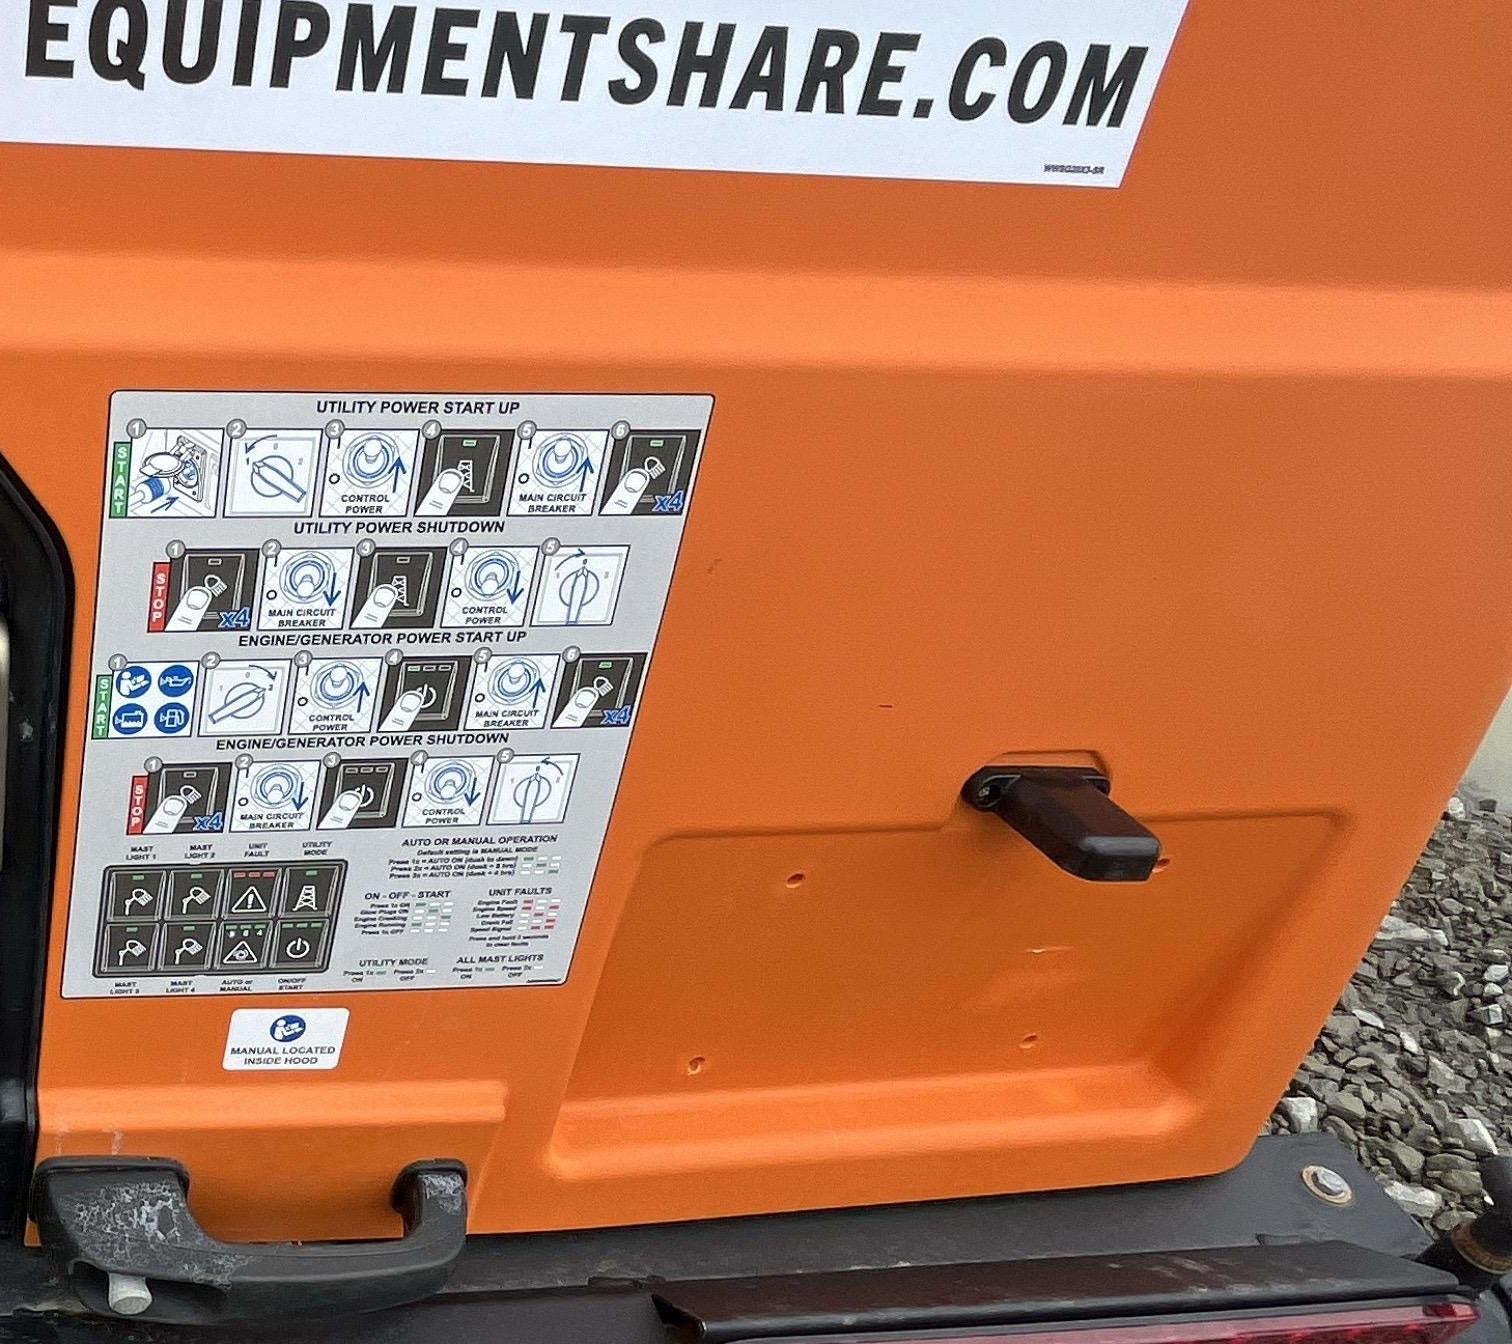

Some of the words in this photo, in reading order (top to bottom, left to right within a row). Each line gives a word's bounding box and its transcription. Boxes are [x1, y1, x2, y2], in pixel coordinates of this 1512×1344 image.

[317, 401, 376, 414] UTILITY
[380, 401, 439, 414] POWER
[443, 401, 495, 414] START
[498, 401, 520, 414] UP
[115, 446, 129, 514] START
[341, 494, 390, 503] CONTROL
[519, 493, 544, 502] MAIN
[546, 493, 587, 502] CIRCUIT
[345, 506, 383, 514] POWER
[528, 505, 576, 513] BREAKER
[294, 522, 352, 534] UTILITY
[355, 522, 413, 534] POWER
[417, 521, 505, 533] SHUTDOWN
[151, 573, 166, 623] STOP
[268, 609, 293, 617] MAIN
[295, 608, 336, 617] CIRCUIT
[462, 606, 508, 614] CONTROL
[238, 633, 392, 647] ENGINE/GENERATOR
[396, 633, 451, 644] POWER
[455, 632, 502, 643] START
[506, 631, 527, 642] UP
[95, 679, 110, 736] START
[308, 714, 354, 722] CONTROL
[503, 710, 539, 718] CIRCUIT
[484, 719, 528, 727] BREAKER
[216, 737, 366, 750] ENGINE/GENERATOR
[370, 736, 423, 747] POWER
[426, 733, 509, 745] SHUTDOWN
[131, 785, 145, 827] STOP
[266, 812, 304, 820] CIRCUIT
[422, 808, 465, 816] CONTROL
[249, 821, 294, 829] BREAKER
[434, 838, 449, 846] OR
[451, 837, 495, 845] MANUAL
[498, 835, 558, 844] OPERATION
[249, 842, 268, 850] UNIT
[244, 850, 270, 858] FAULT
[365, 892, 380, 900] ON
[388, 891, 410, 899] OFF
[418, 890, 451, 898] START
[489, 888, 510, 896] UNIT
[514, 887, 552, 896] FAULTS
[359, 959, 396, 967] UTILITY
[456, 956, 476, 964] ALL
[479, 955, 507, 963] MAST
[508, 954, 544, 962] LIGHTS
[230, 1047, 279, 1055] MANUAL
[282, 1046, 336, 1054] LOCATED
[244, 1057, 282, 1065] INSIDE
